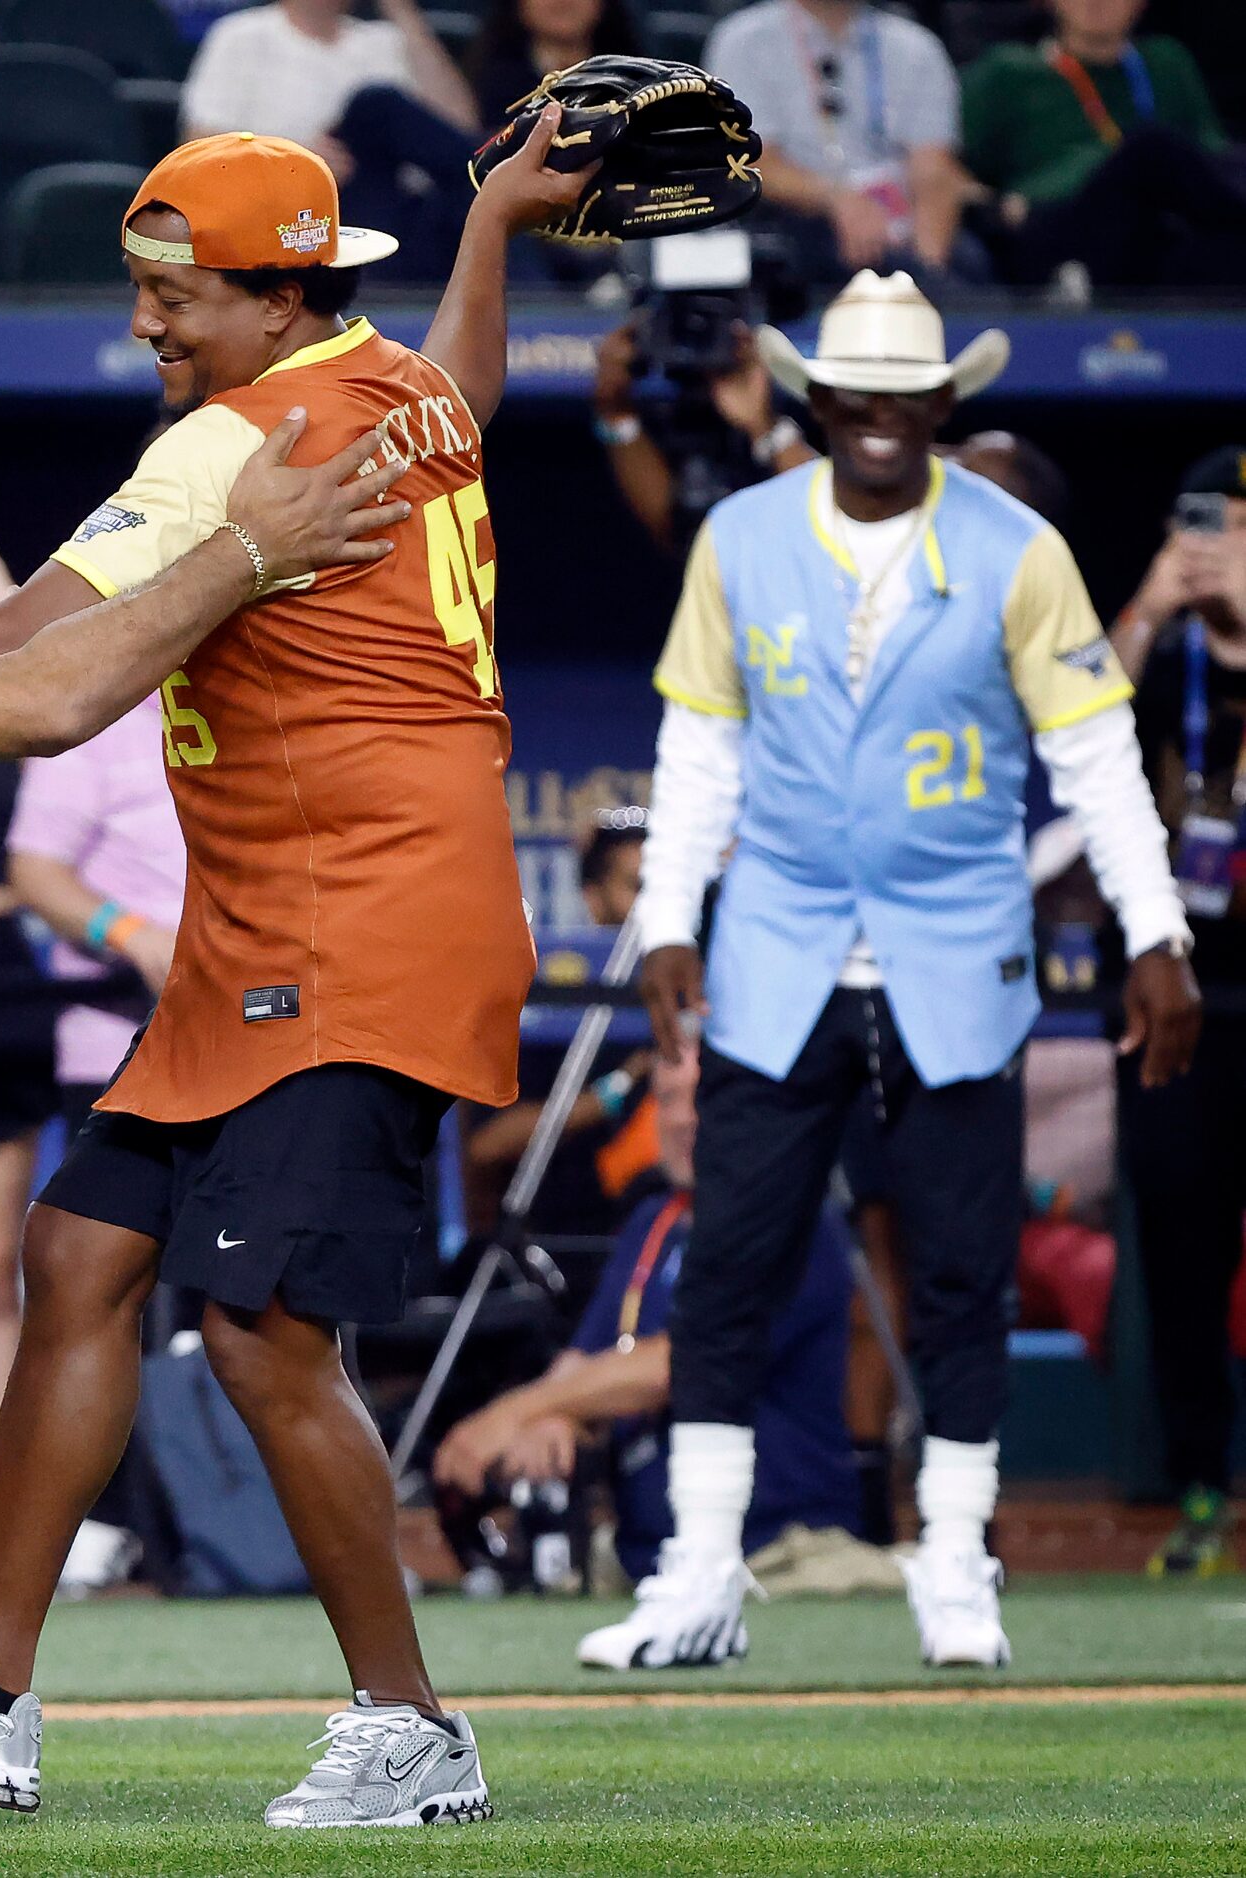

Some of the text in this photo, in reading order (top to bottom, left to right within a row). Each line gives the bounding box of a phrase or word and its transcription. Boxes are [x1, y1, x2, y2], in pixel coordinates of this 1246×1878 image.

[280, 224, 330, 243] CELEBRITY
[746, 624, 808, 696] NL
[905, 723, 987, 812] 21
[282, 995, 288, 1008] L
